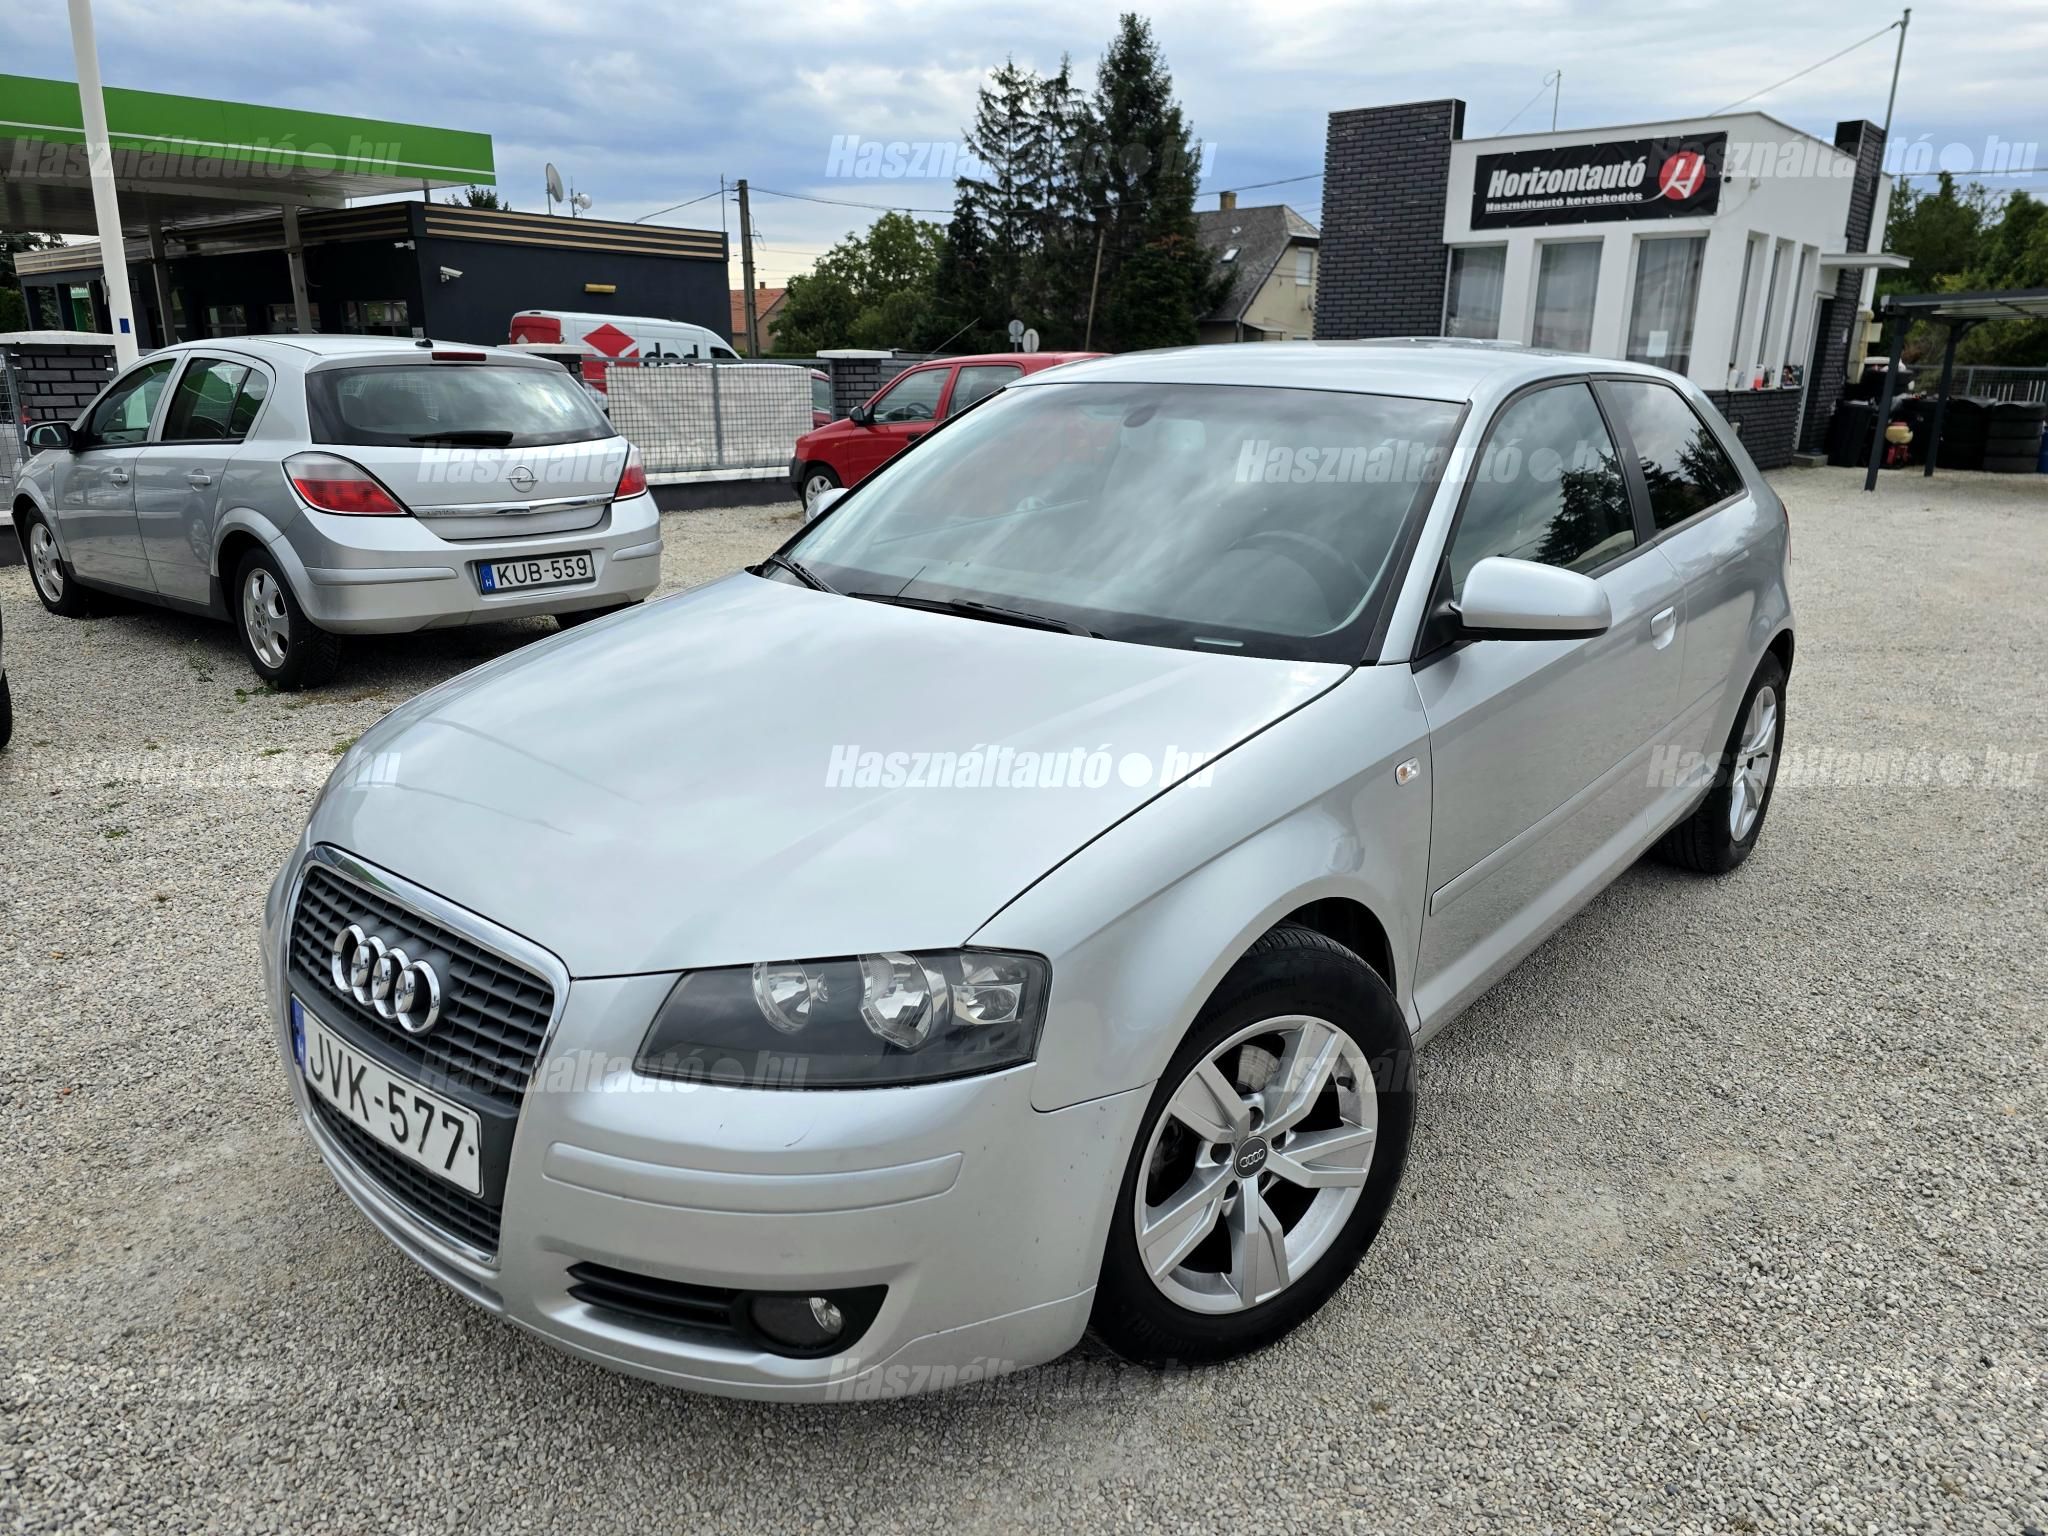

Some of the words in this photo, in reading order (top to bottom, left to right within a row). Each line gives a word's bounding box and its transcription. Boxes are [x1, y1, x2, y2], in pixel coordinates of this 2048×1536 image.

[1487, 156, 1647, 198] Horizontautó
[497, 557, 588, 586] KUB-559
[310, 1032, 465, 1171] JVK-577
